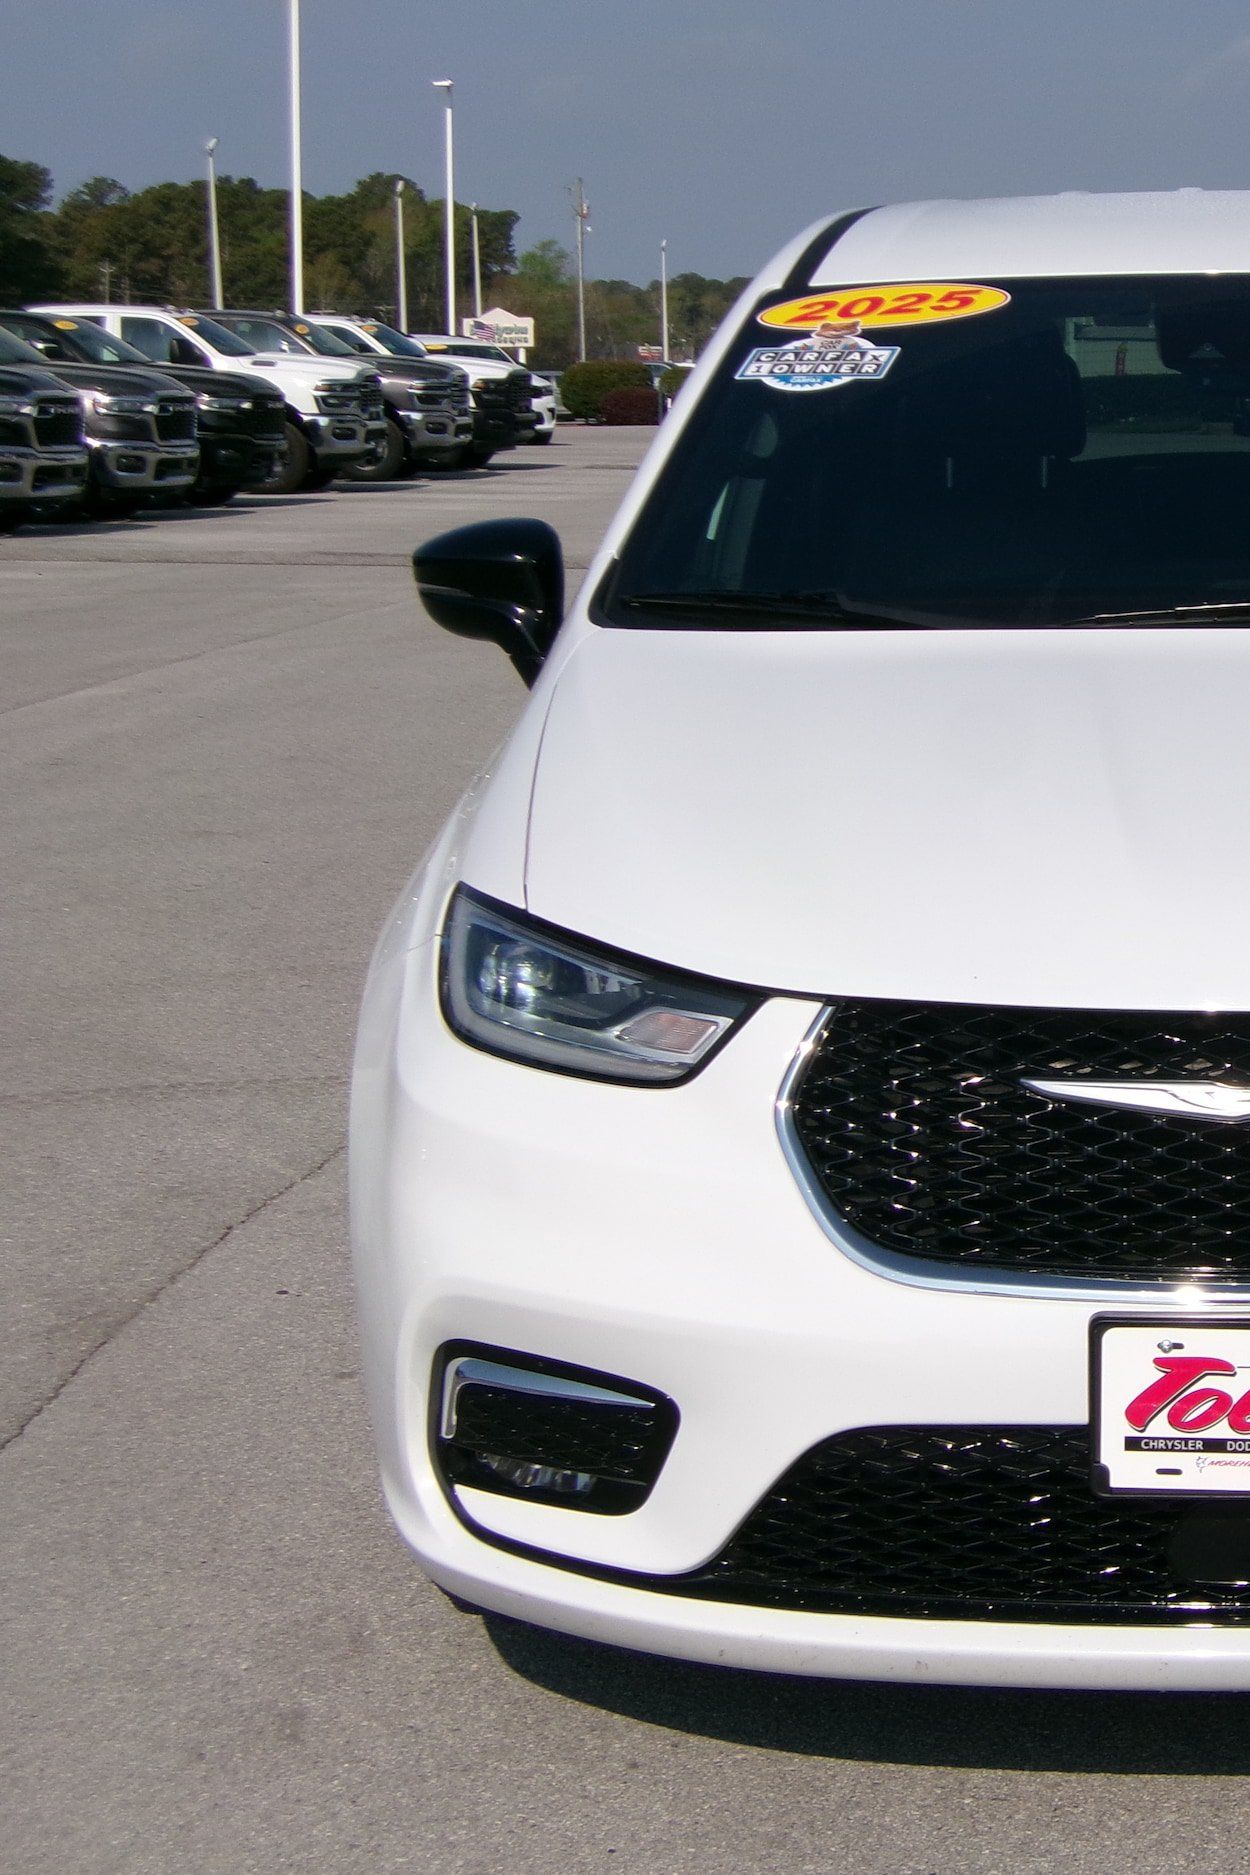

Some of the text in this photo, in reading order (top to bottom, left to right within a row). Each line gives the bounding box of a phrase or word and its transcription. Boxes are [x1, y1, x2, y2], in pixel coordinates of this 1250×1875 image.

[783, 289, 983, 324] 2025
[759, 351, 886, 362] CARFAX
[772, 364, 878, 373] OWNER
[1141, 1438, 1203, 1450] CHRYSLER
